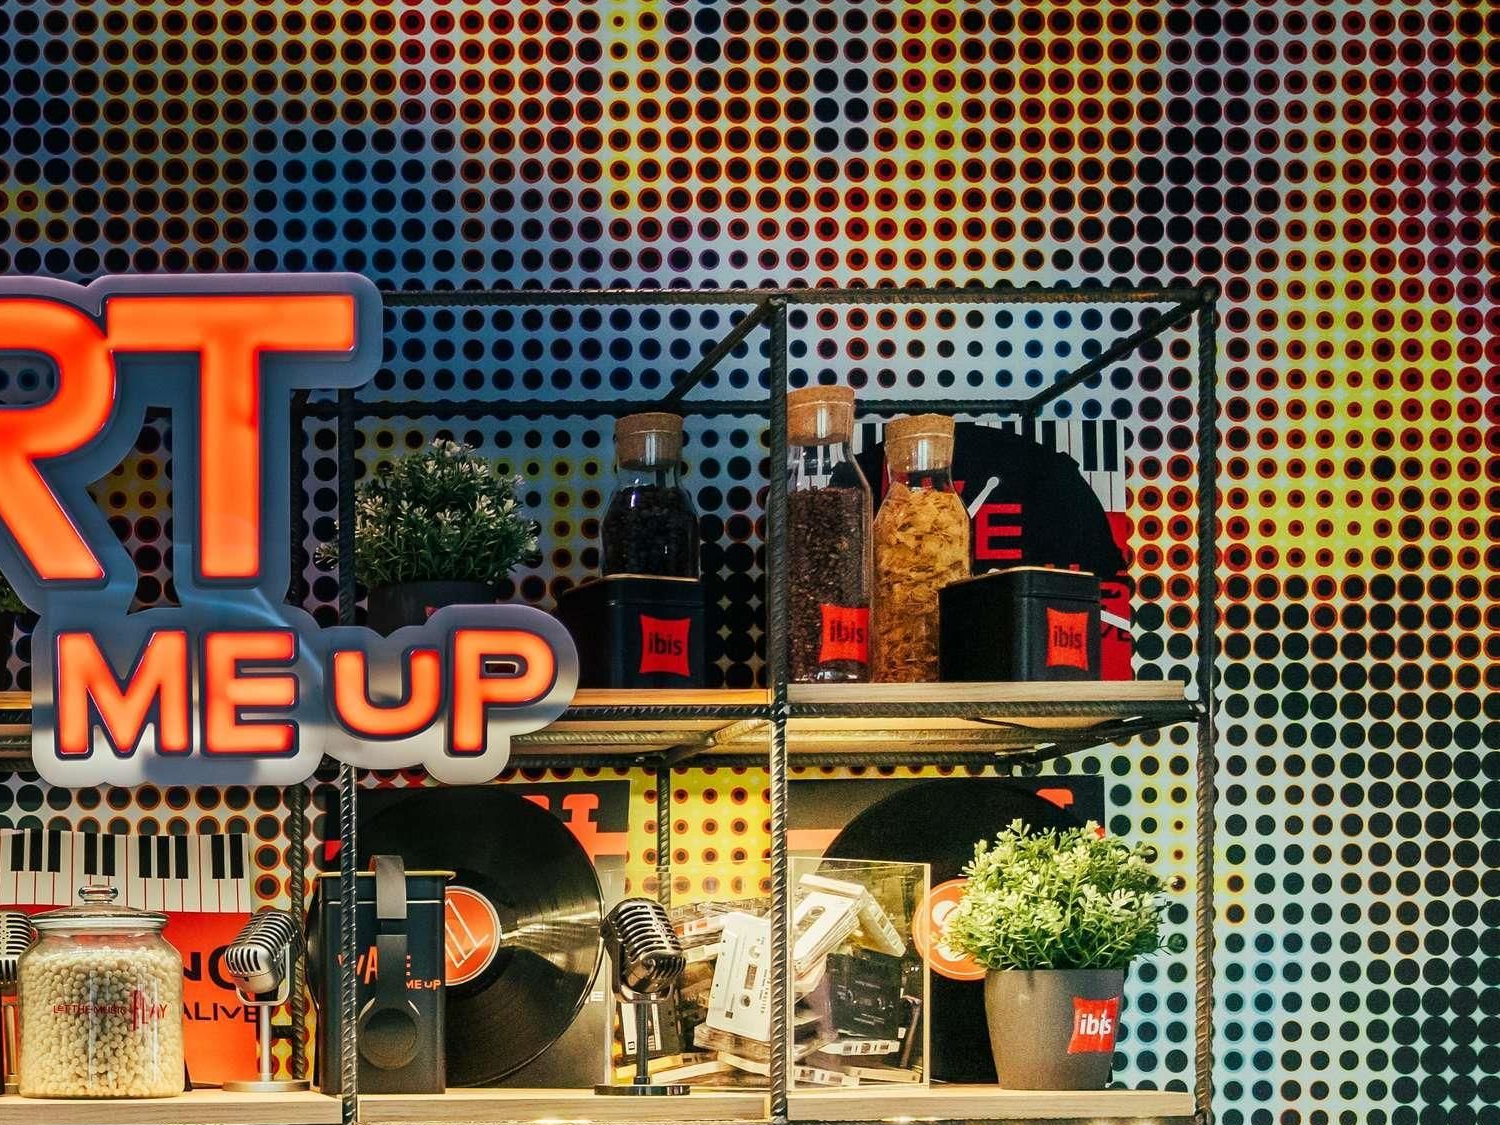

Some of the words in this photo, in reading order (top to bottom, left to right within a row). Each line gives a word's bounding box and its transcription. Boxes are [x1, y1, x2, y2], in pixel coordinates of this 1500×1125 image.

[829, 619, 864, 644] ibis
[1053, 625, 1082, 649] ibis
[648, 632, 683, 656] ibis
[56, 630, 296, 755] ME
[331, 628, 556, 754] UP
[53, 1003, 70, 1014] LET
[1080, 1013, 1112, 1035] ibis
